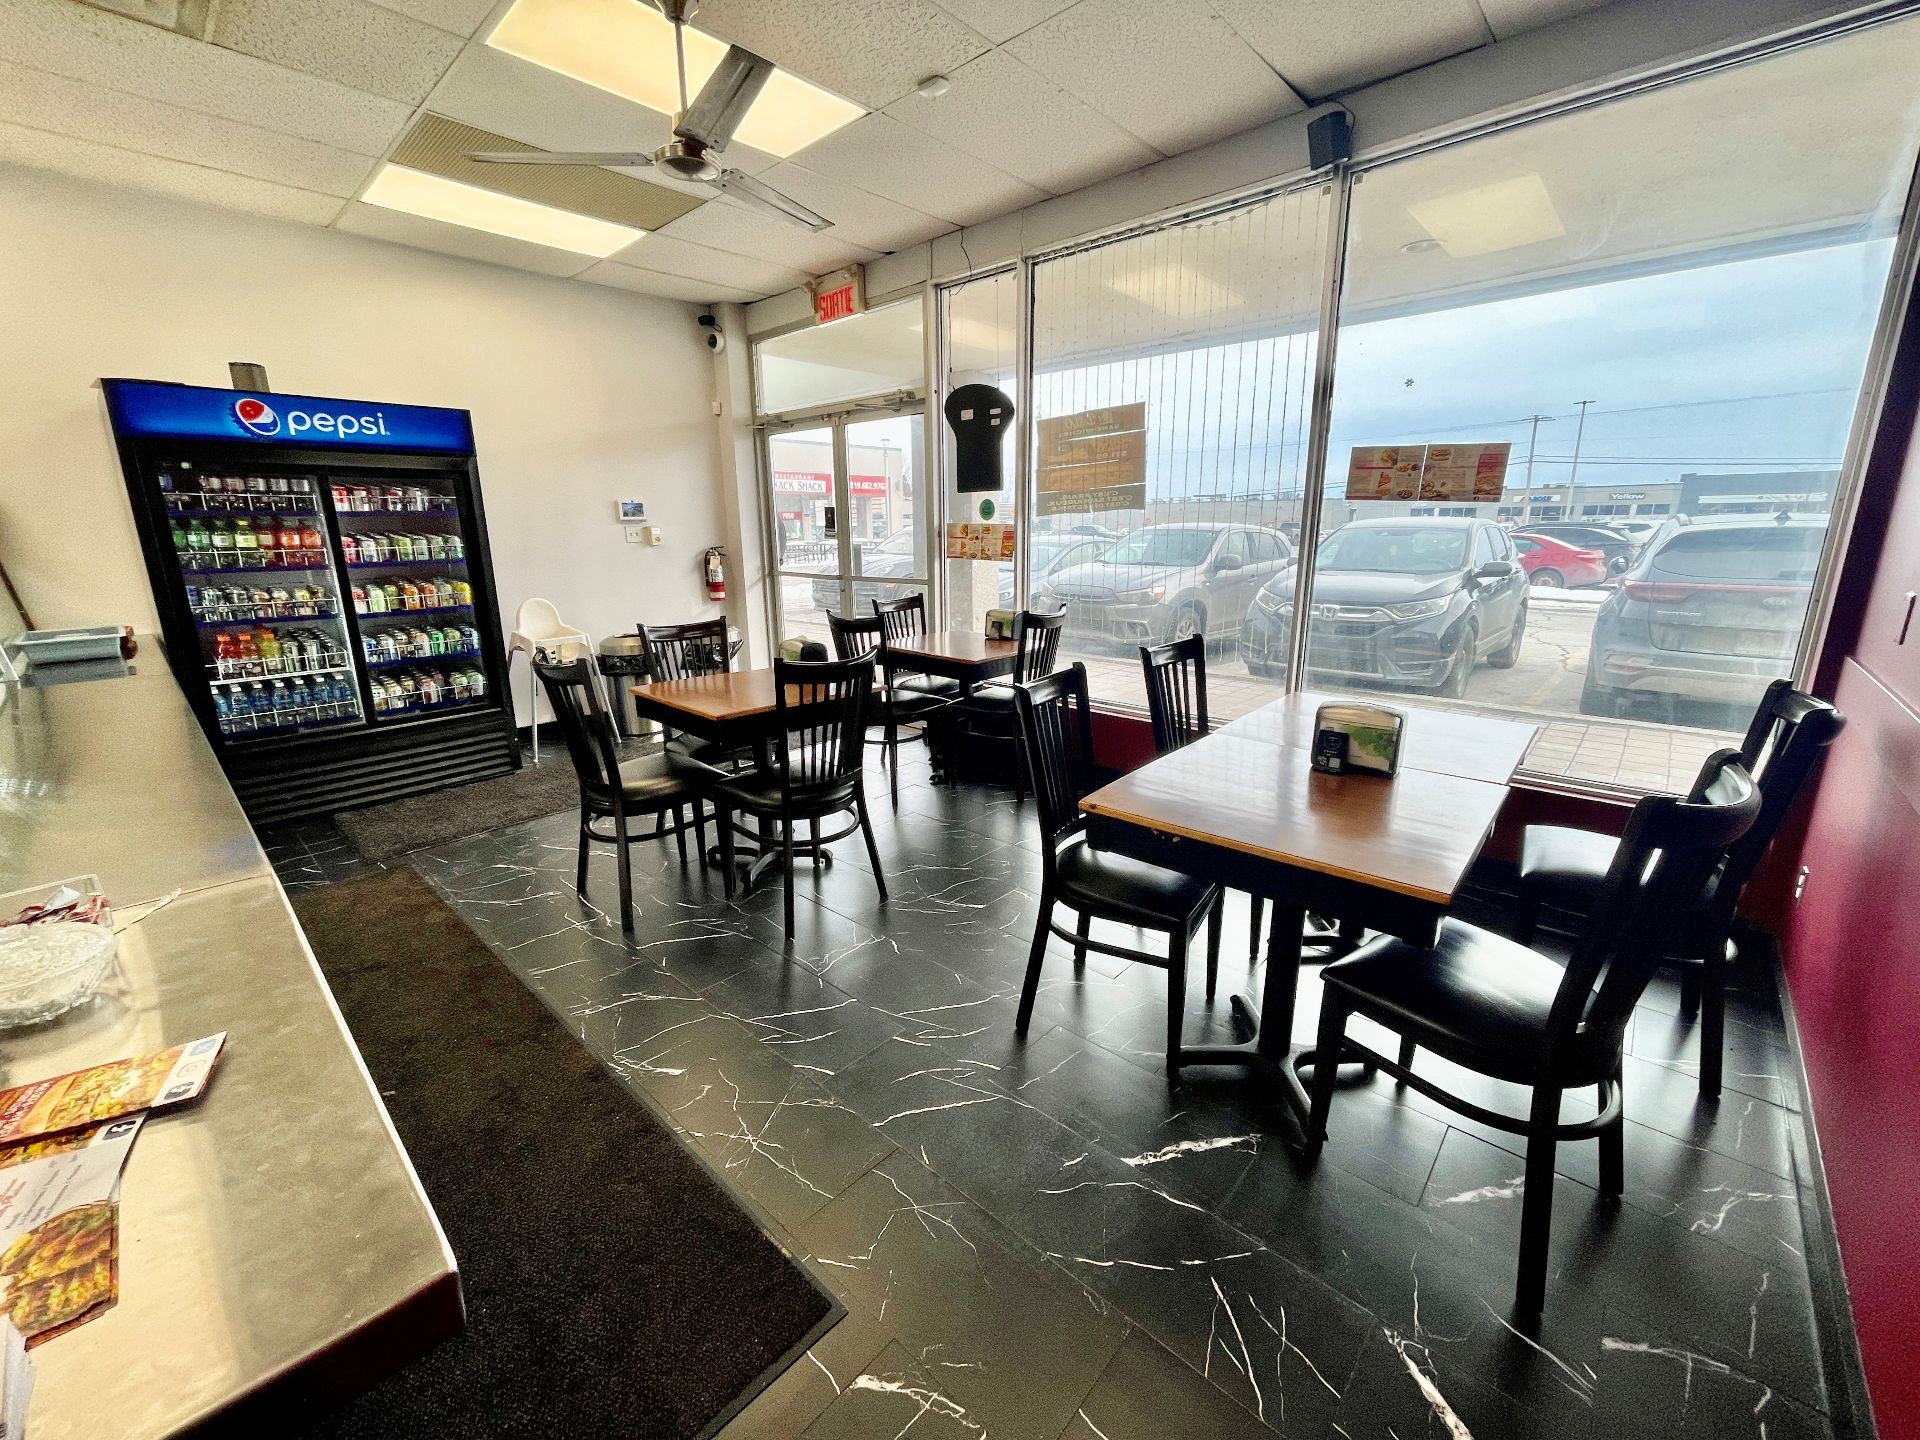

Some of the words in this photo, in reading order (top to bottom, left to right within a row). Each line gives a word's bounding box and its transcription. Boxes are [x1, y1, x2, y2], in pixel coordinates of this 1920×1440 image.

[819, 285, 855, 321] SORTIE
[287, 411, 386, 439] pepsi
[797, 481, 824, 491] SHACK
[1611, 493, 1645, 501] Yellow
